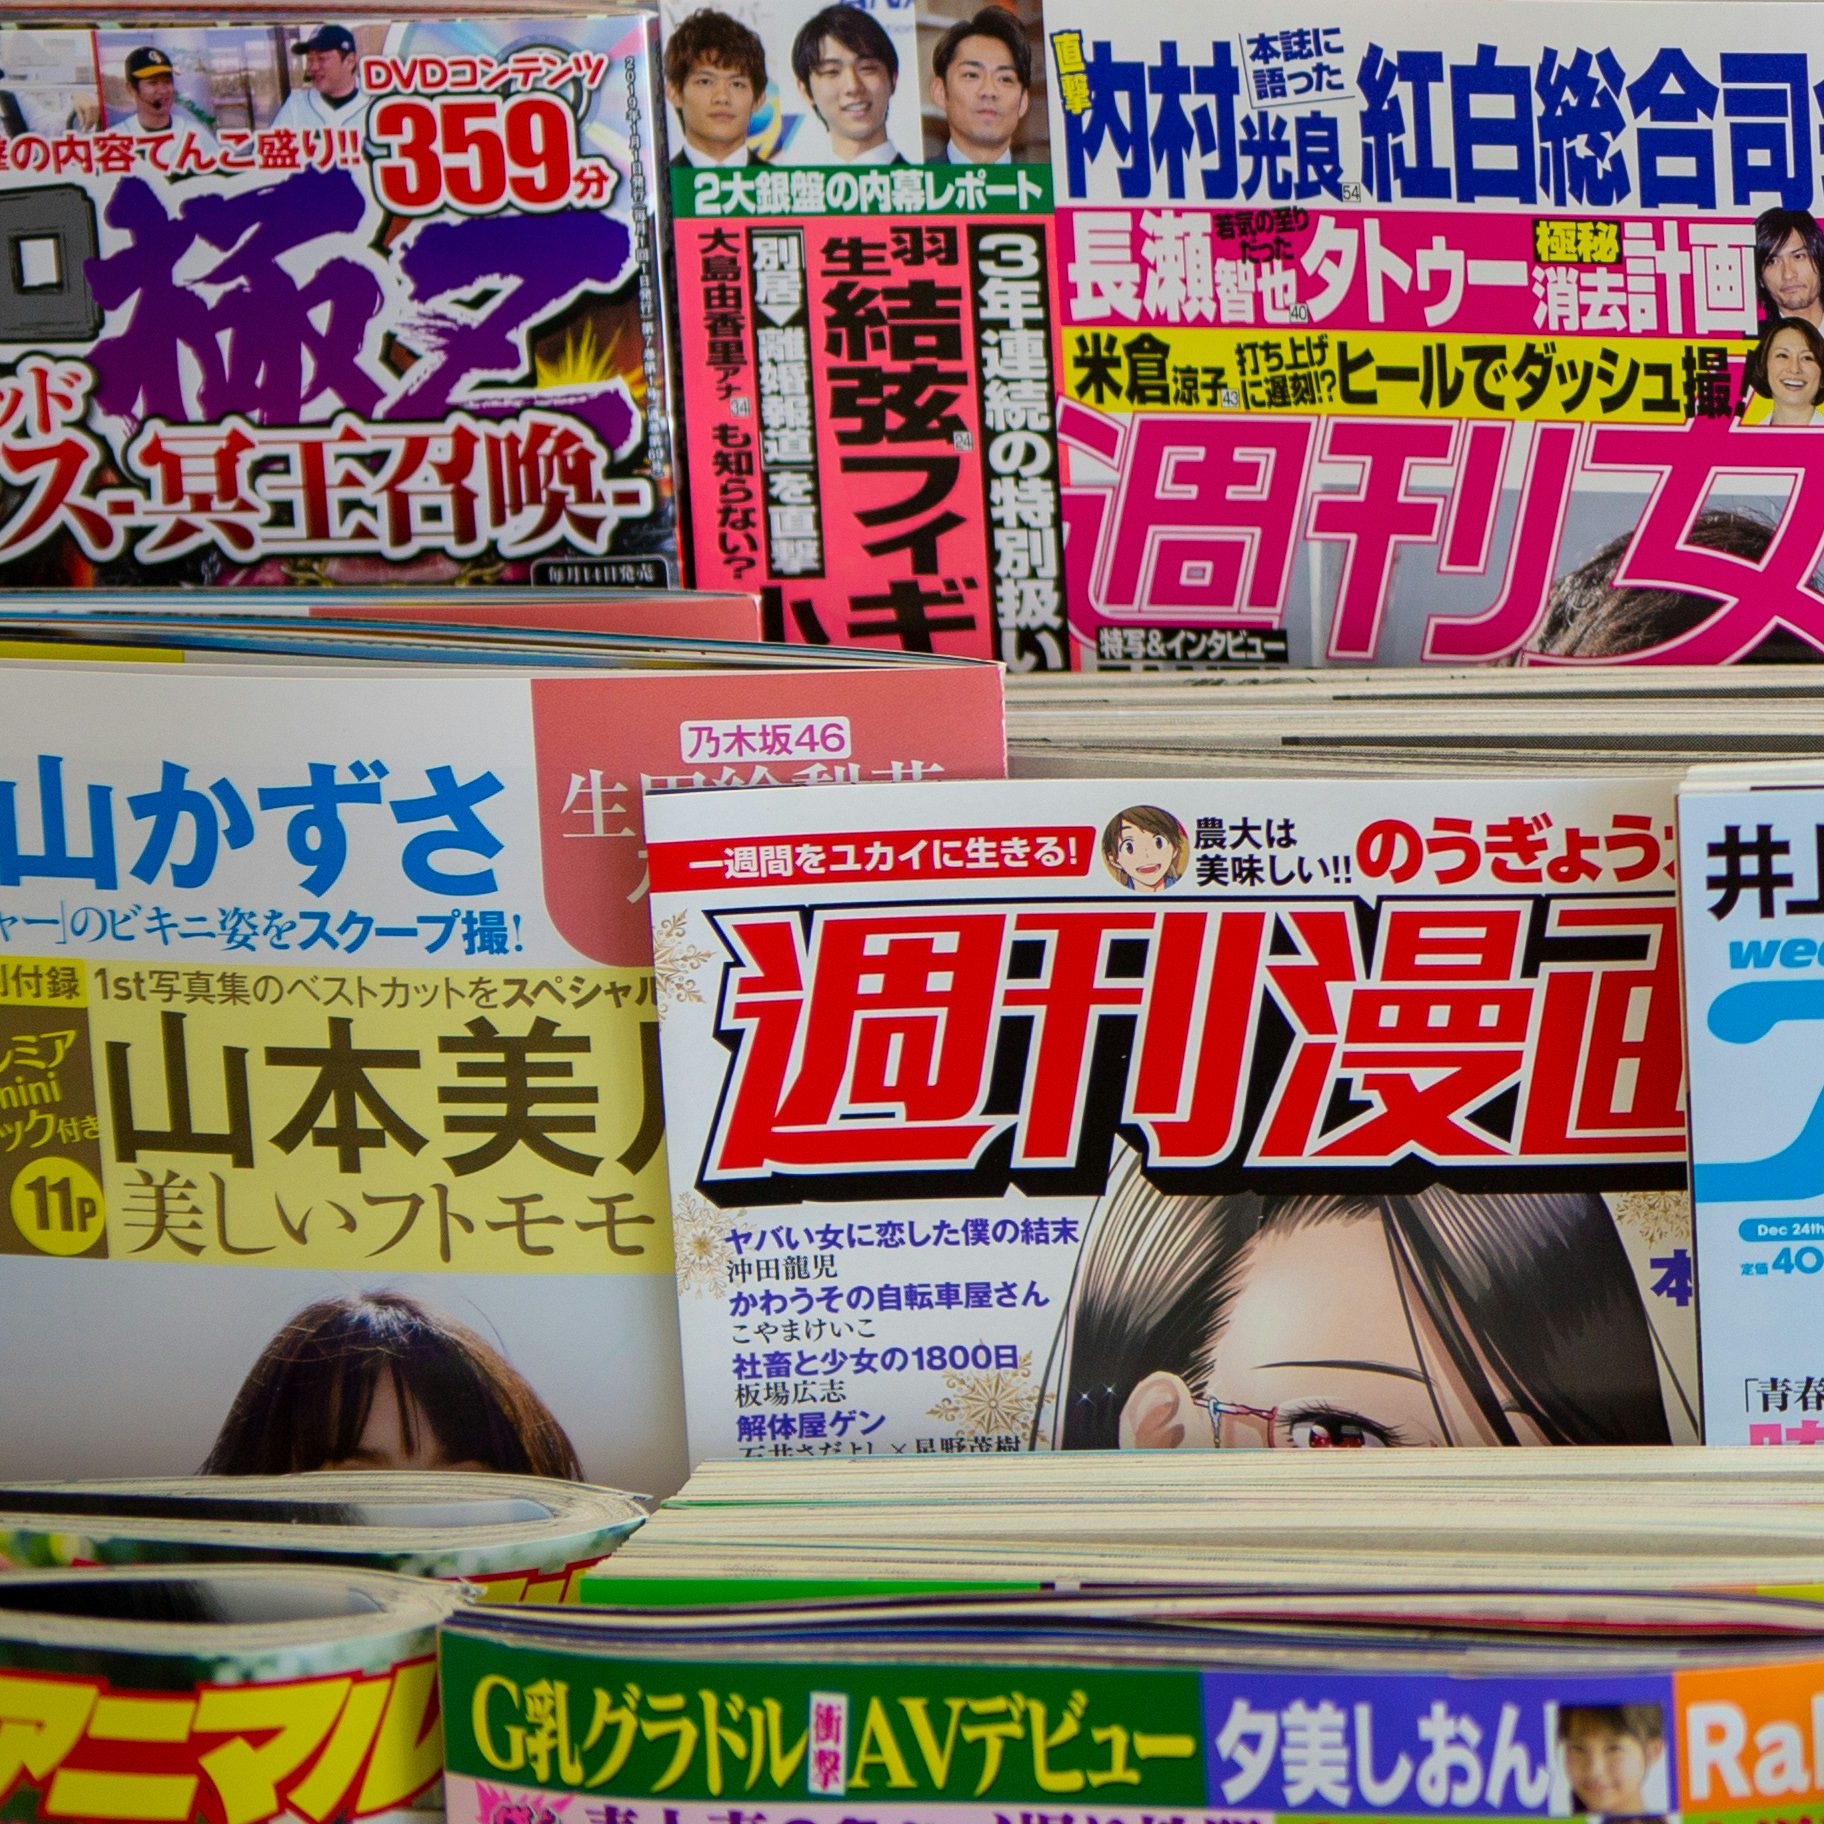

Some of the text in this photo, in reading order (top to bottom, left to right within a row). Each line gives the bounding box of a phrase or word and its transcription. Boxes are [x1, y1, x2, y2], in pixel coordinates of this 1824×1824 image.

[1246, 26, 1344, 61] 本誌に
[362, 53, 608, 92] DVDコンテンツ
[1252, 61, 1346, 101] 語った
[693, 169, 1045, 216] 2大銀盤の内幕レポート
[1212, 207, 1309, 238] 若気の至り
[1533, 221, 1621, 264] 極秘
[1301, 214, 1530, 329] タトゥー
[1622, 221, 1759, 337] 計画
[1531, 266, 1627, 332] 消去
[1234, 335, 1329, 377] 打ち上げ
[976, 233, 1069, 673] 3年連続の特別扱い
[688, 723, 845, 759] 乃木坂46
[1193, 817, 1298, 852] 農大は
[122, 1167, 656, 1263] 美しいフトモモ
[723, 1215, 1081, 1257] ヤバい女に恋した僕の結末
[725, 1254, 839, 1283] 沖田龍児
[729, 1279, 1050, 1318] かわうその自転車屋さん
[730, 1317, 878, 1345] こやまけいこ
[731, 1343, 1020, 1381] 社畜と少女の1800日
[734, 1380, 848, 1409] 板場広志
[735, 1407, 887, 1444] 解体屋ゲン
[471, 1672, 1197, 1800] G乳グラドル AVデビュー
[1213, 1700, 1557, 1809] 夕美しおん
